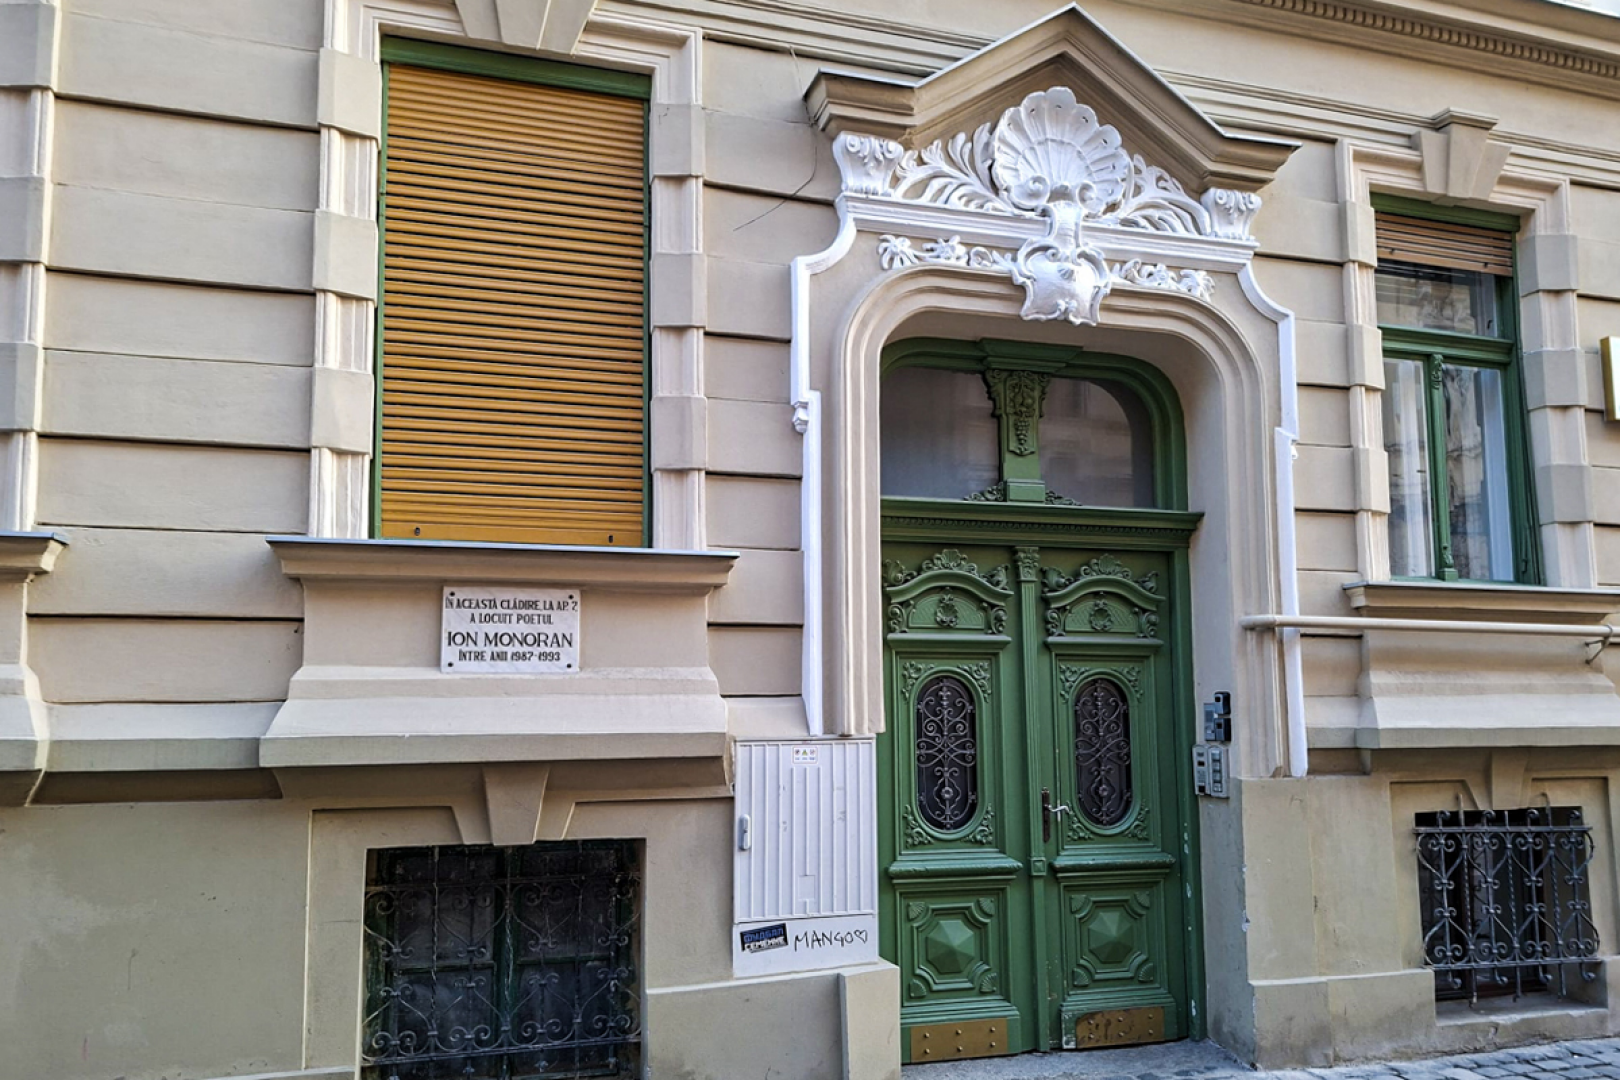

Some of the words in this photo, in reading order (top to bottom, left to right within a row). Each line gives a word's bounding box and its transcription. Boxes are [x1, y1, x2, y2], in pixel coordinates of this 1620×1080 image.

[543, 600, 554, 611] LA
[470, 613, 476, 624] A
[478, 613, 513, 624] LOCUIT
[516, 613, 554, 625] POETUL
[447, 631, 478, 646] ION
[484, 632, 573, 648] MONORAN
[458, 648, 487, 661] ÎNTRE
[489, 651, 508, 661] ANII
[511, 651, 561, 661] 1987-1993
[794, 930, 854, 952] MANGO
